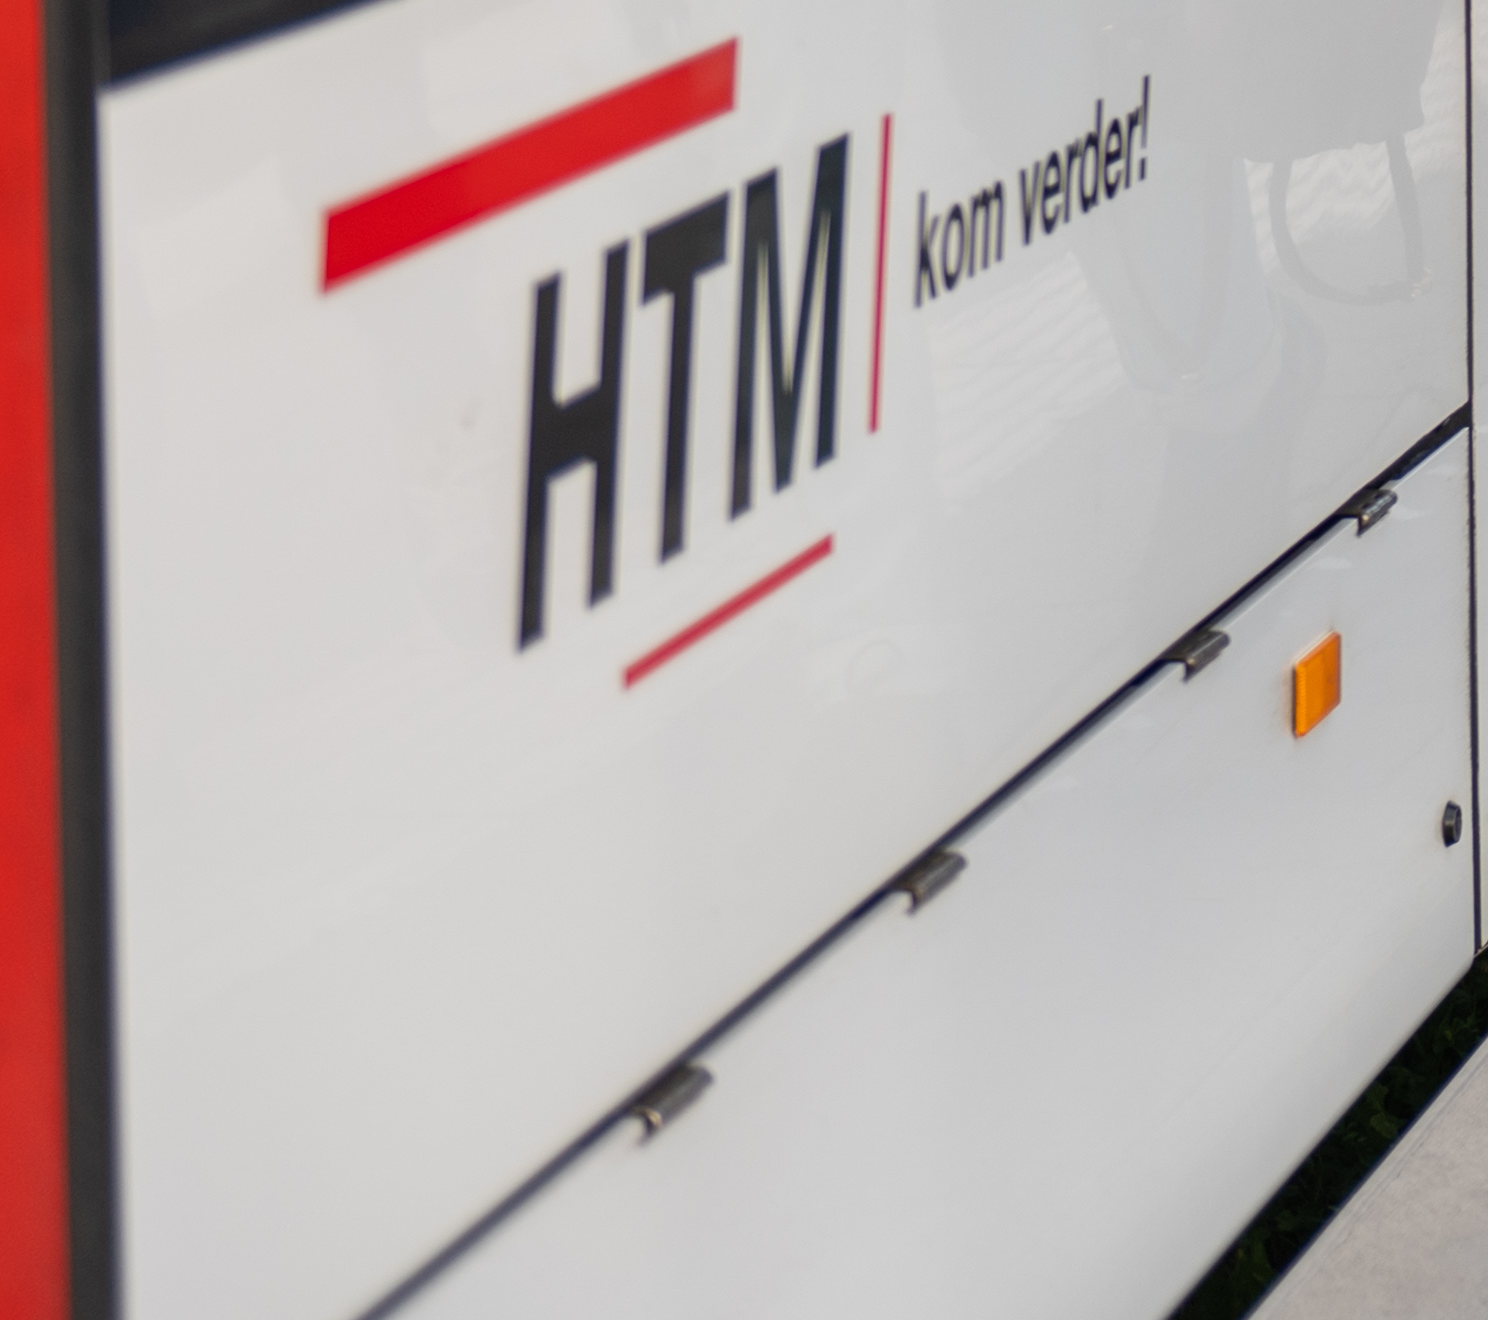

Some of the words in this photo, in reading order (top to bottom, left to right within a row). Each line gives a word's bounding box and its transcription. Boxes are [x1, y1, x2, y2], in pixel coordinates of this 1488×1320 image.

[913, 179, 1005, 310] kom
[1017, 73, 1151, 247] verder!
[516, 131, 852, 654] HTM
